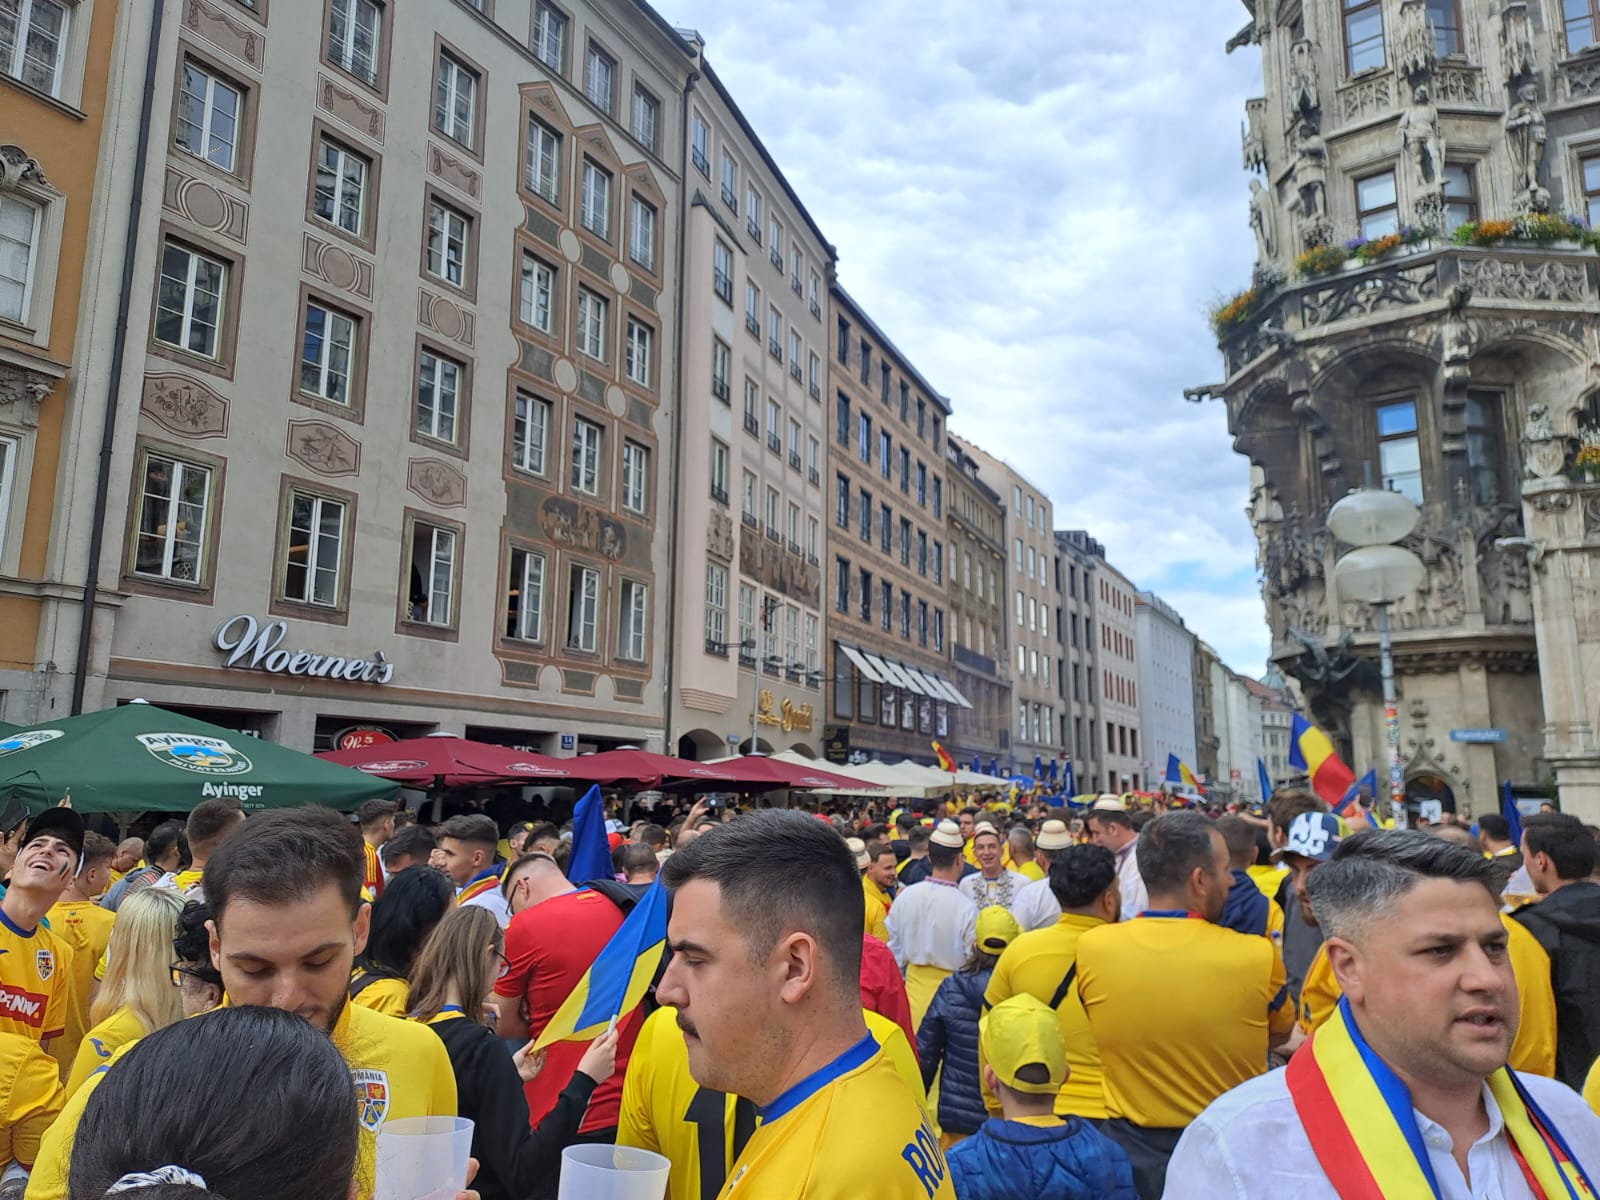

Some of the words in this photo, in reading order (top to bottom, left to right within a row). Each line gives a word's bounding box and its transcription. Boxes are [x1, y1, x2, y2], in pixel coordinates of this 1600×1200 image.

[212, 614, 394, 684] Woerner's
[144, 735, 226, 750] Ayinger
[202, 781, 264, 801] Ayinger
